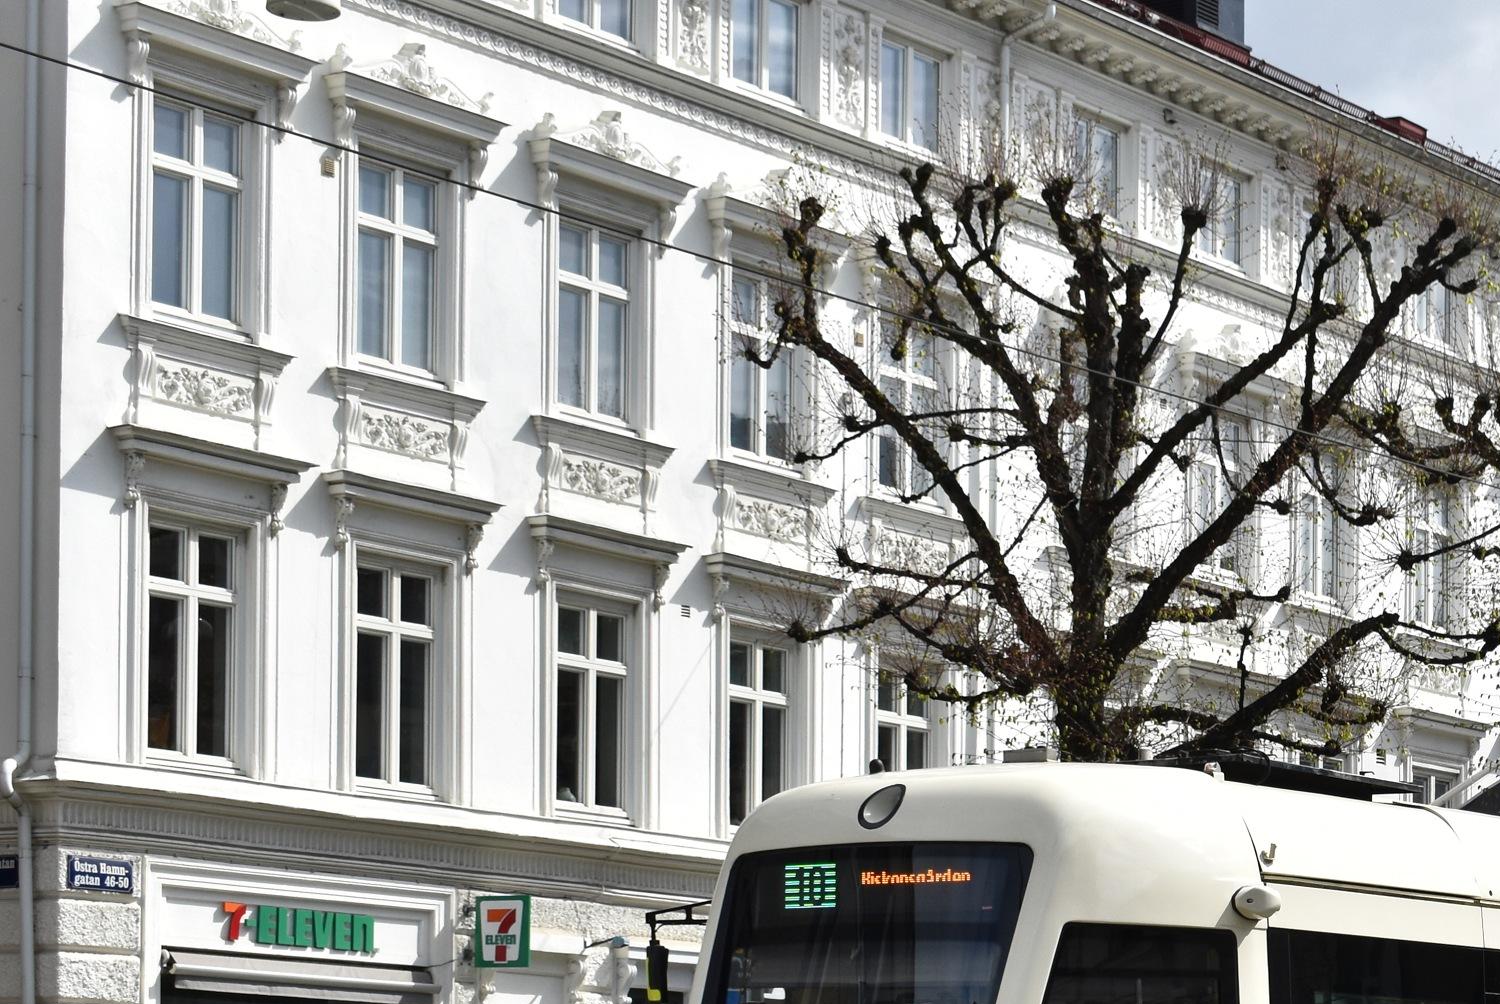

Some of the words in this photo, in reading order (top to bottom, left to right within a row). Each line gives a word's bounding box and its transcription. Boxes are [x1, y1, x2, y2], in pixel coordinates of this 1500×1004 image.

[74, 858, 98, 873] Östra
[100, 863, 129, 876] Hamn-
[74, 874, 100, 887] gatan
[105, 877, 130, 889] 46-50
[487, 909, 516, 961] 7
